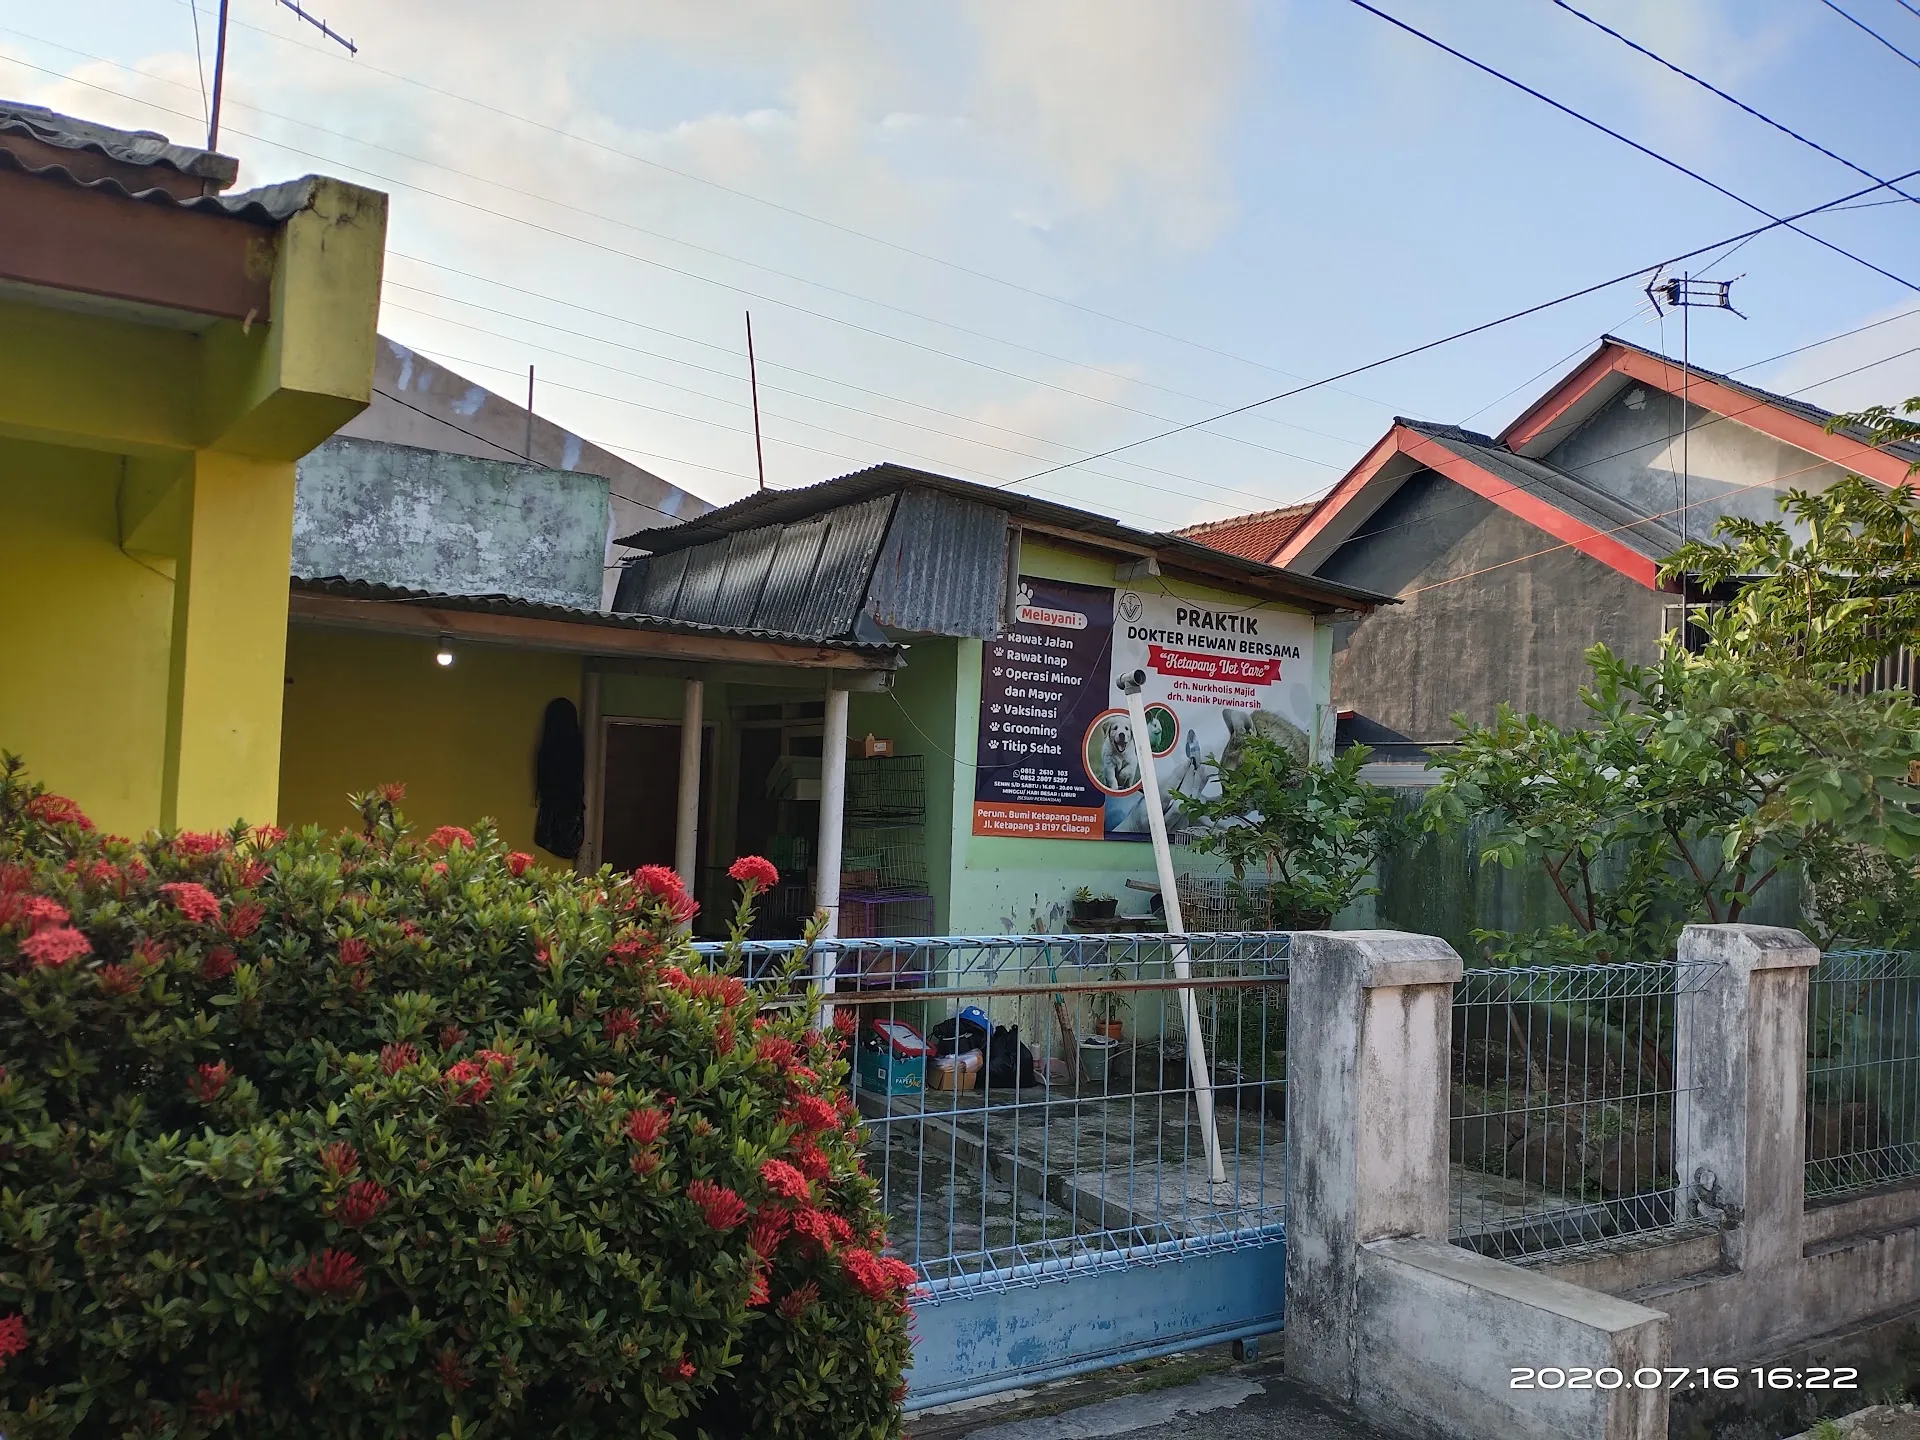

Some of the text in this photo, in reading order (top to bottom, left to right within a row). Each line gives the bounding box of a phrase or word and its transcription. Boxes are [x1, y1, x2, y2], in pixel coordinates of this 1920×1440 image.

[1021, 608, 1076, 625] Melayani
[1176, 607, 1259, 636] PRAKTIK
[1007, 632, 1074, 649] Rawat Jalan
[1127, 626, 1300, 660] DOKTER HEWAN BERSAMA
[1006, 649, 1068, 668] Rawat Inap
[1219, 659, 1239, 675] Vet
[1005, 667, 1083, 686] Operasi Minor
[1004, 685, 1063, 702] dan Mayor
[1173, 680, 1256, 697] drh. Nurkholis Majid
[1167, 692, 1262, 709] drh. Nanik Purwinarsih
[1003, 703, 1058, 719] Vaksinasi
[1002, 722, 1058, 739] Grooming
[1001, 740, 1062, 755] Titip Sehat
[977, 809, 1097, 823] Perum. Bumi Ketapang Damai
[994, 821, 1034, 832] Ketapang
[1035, 823, 1040, 831] 3
[1061, 824, 1091, 834] Cilacap
